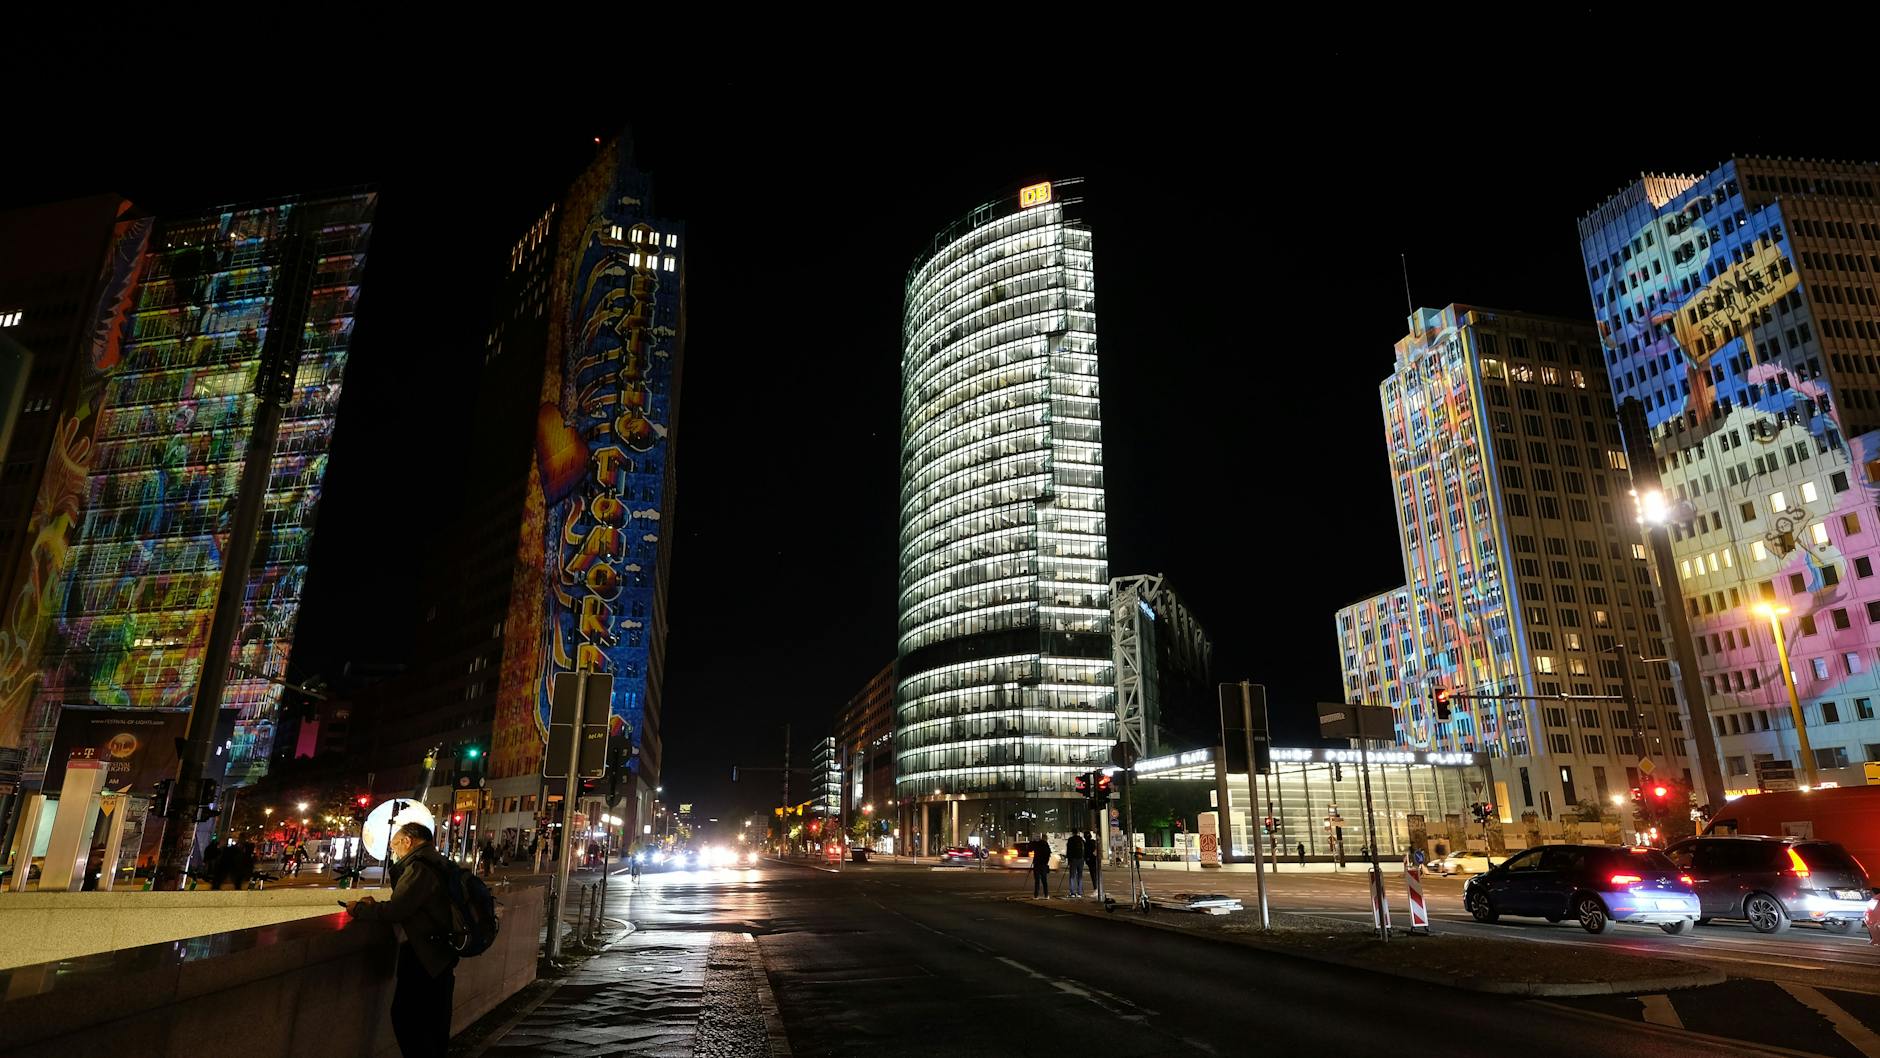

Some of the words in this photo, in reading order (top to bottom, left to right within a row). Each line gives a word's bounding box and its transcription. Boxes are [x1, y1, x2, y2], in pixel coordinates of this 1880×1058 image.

[1024, 185, 1048, 203] DB
[1698, 262, 1765, 316] SAVE
[1699, 313, 1724, 337] THE
[1724, 264, 1782, 321] PLANET
[1765, 505, 1806, 546] SOS
[84, 748, 95, 759] T
[1181, 749, 1208, 765] PLATZ
[1269, 750, 1312, 761] NHOF
[1324, 750, 1415, 763] POTSDAMER
[1426, 753, 1473, 764] PLATZ
